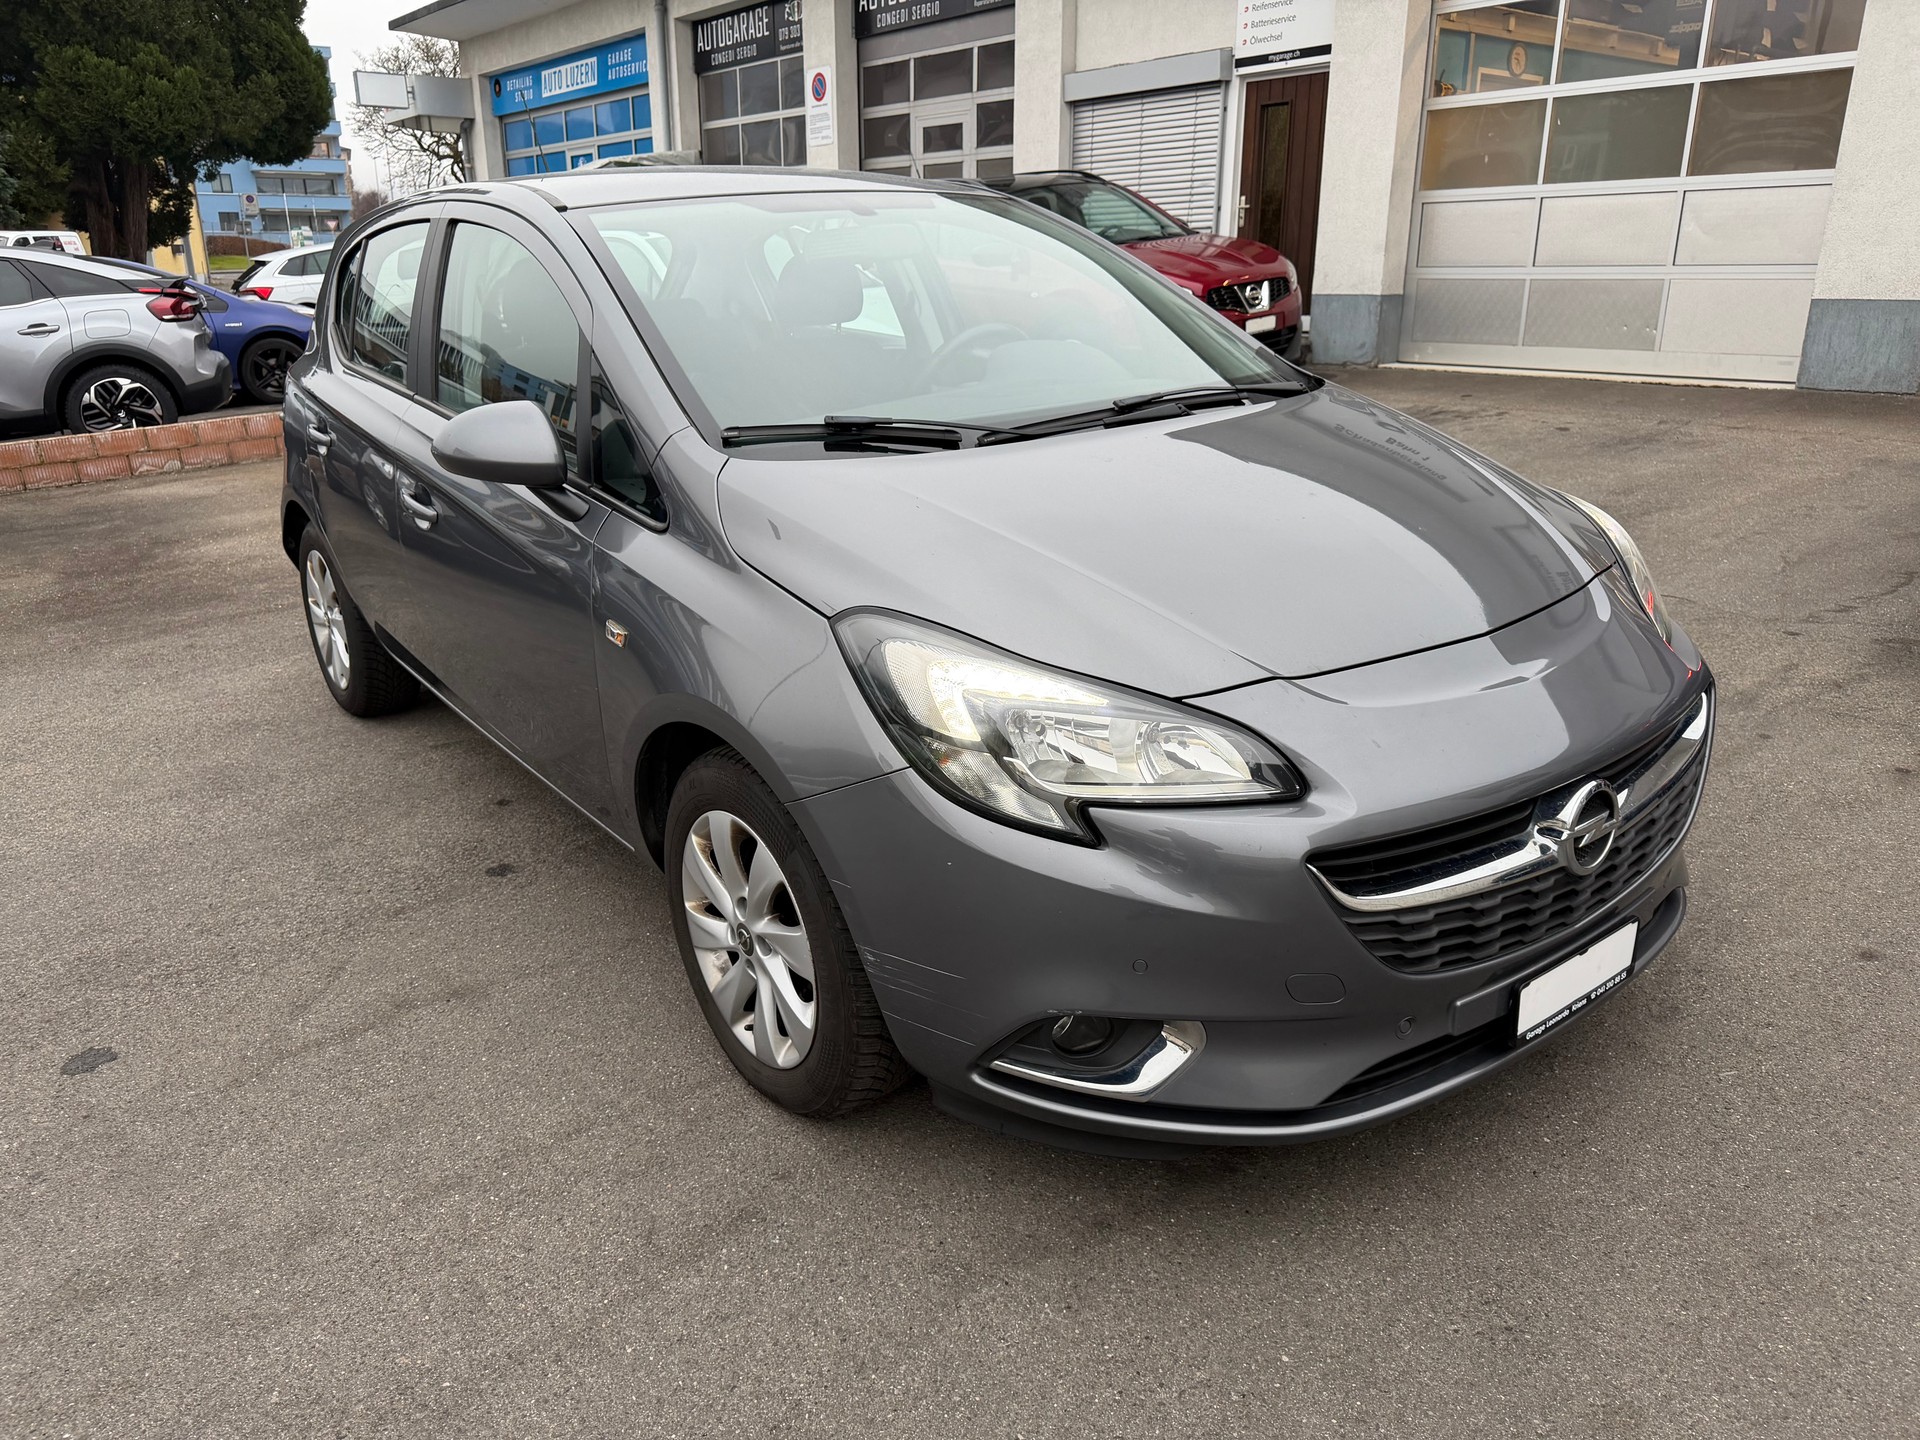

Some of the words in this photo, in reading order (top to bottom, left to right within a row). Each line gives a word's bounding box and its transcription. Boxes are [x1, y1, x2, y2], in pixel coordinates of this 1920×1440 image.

[876, 7, 909, 28] CONGEDI
[911, 1, 940, 20] SERGIO
[1252, 0, 1293, 12] Reifenservice
[697, 6, 770, 53] AUTOGARAGE
[1250, 14, 1297, 29] Batterieservice
[1249, 32, 1283, 45] Ölwechsel
[608, 48, 632, 66] GARAGE
[711, 49, 735, 66] CONGEDI
[736, 43, 758, 60] SERGIO
[1267, 50, 1301, 62] mygarage.ch
[543, 70, 563, 93] AUTO
[566, 60, 596, 88] LUZERN
[608, 60, 649, 80] AUTOSERVIC
[506, 75, 533, 91] DETAILING
[1525, 1024, 1546, 1040] Garage
